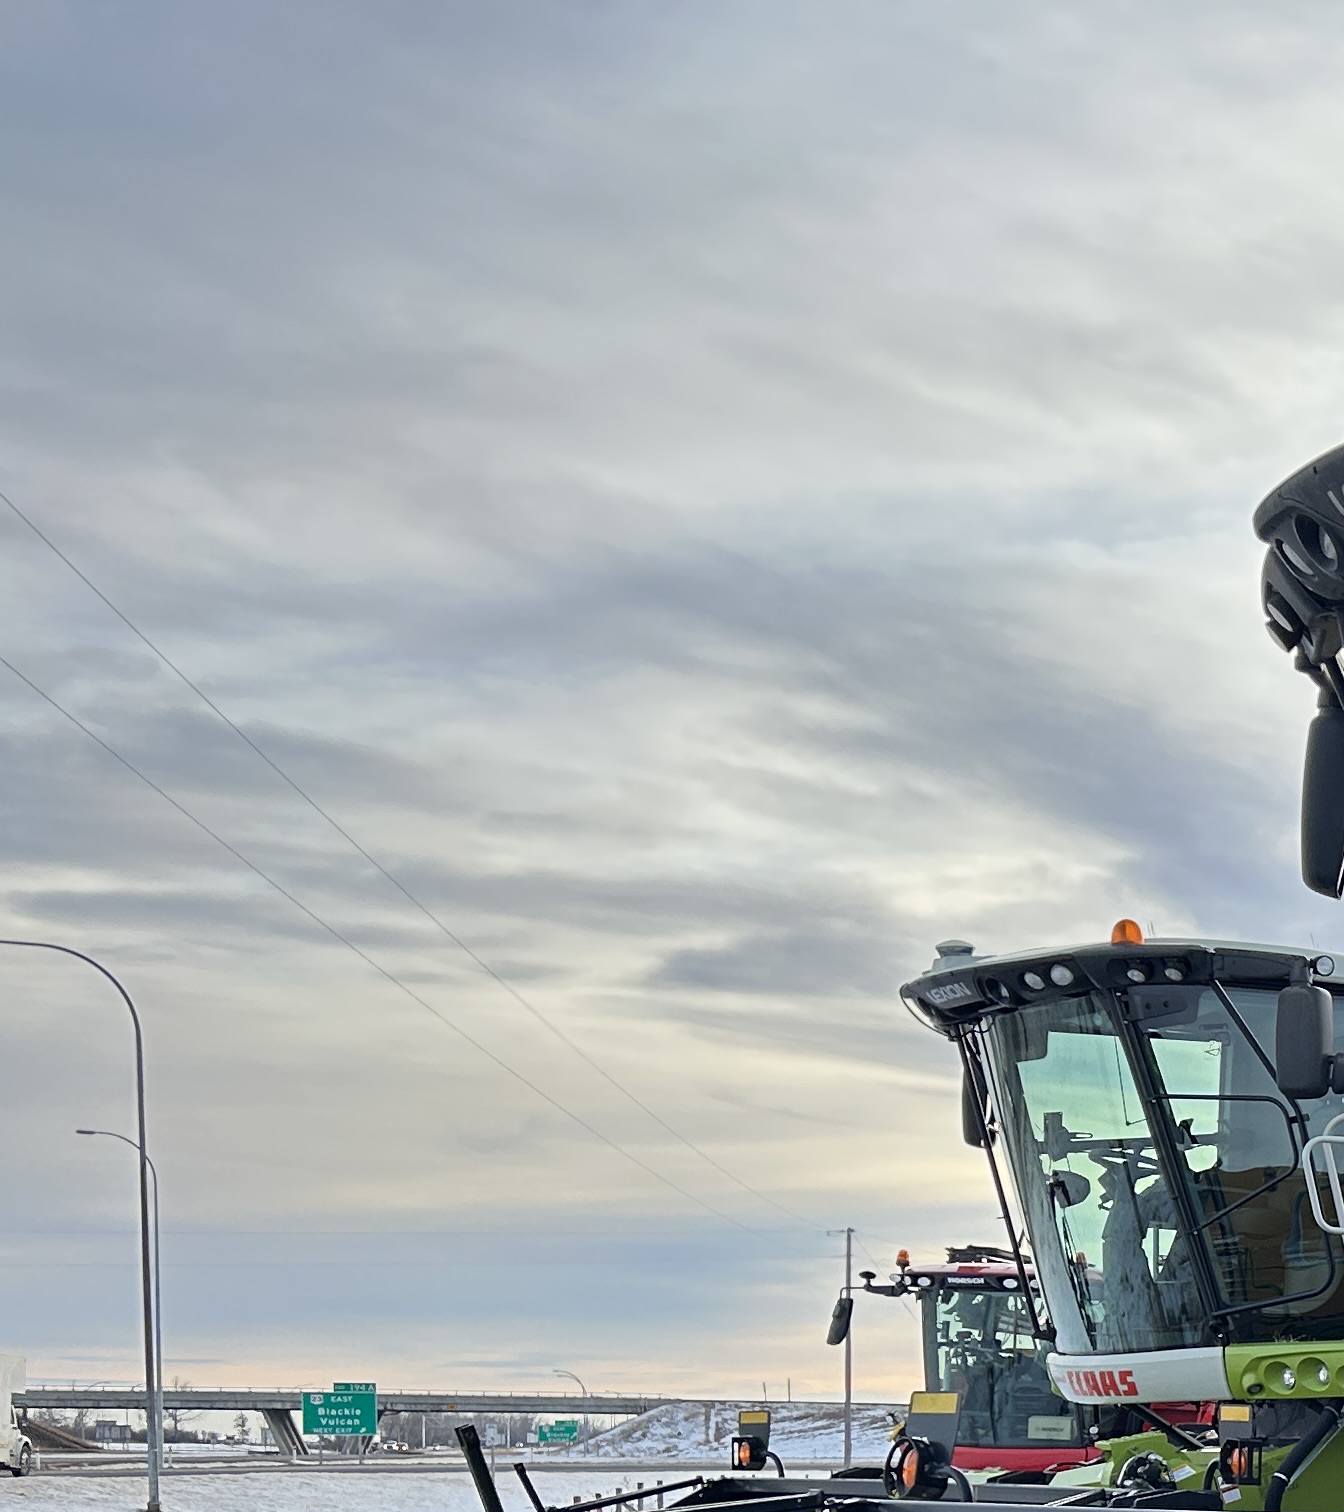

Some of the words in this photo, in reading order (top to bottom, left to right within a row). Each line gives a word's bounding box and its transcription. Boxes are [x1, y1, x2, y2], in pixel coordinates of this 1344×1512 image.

[926, 982, 972, 1003] LEXION
[1066, 1370, 1139, 1397] CLAAS
[317, 1407, 362, 1416] Blackie
[320, 1417, 361, 1426] Vulcan
